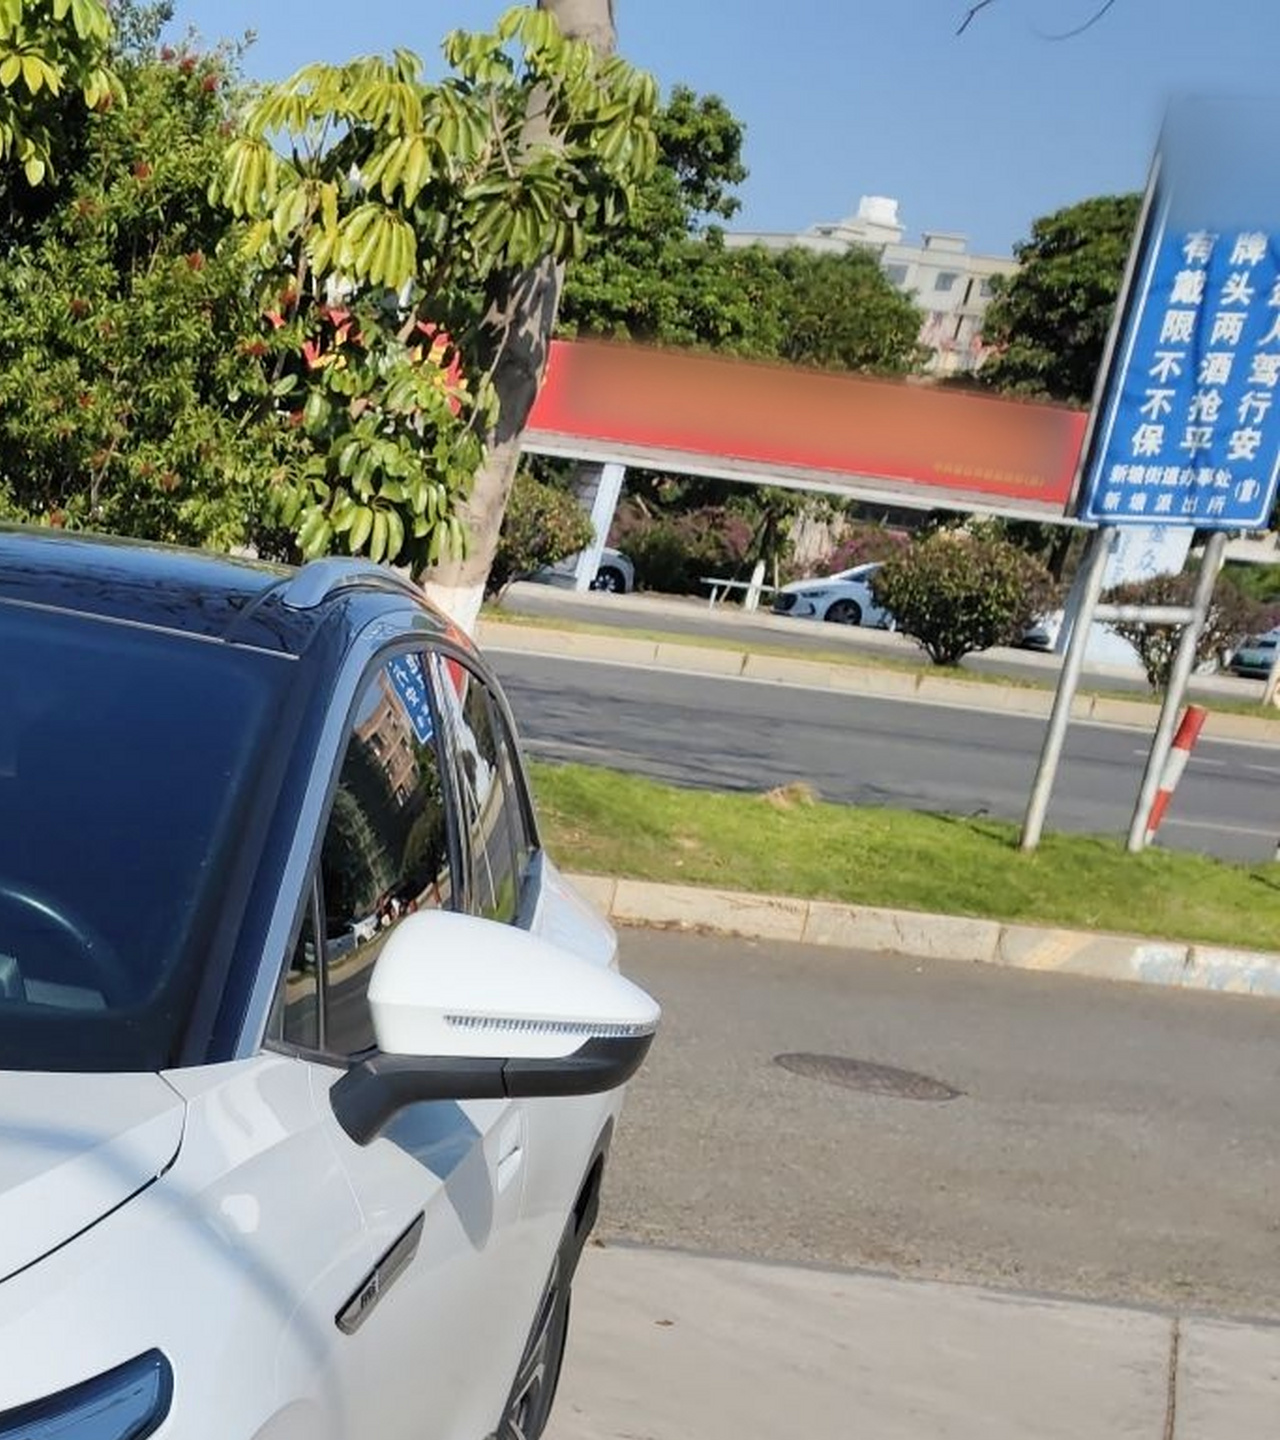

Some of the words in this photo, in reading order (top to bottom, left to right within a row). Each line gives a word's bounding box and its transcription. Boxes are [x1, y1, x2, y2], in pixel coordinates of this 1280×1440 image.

[1149, 351, 1280, 387] 不酒驾
[1140, 388, 1273, 425] 不抢行
[1131, 423, 1262, 461] 保平安
